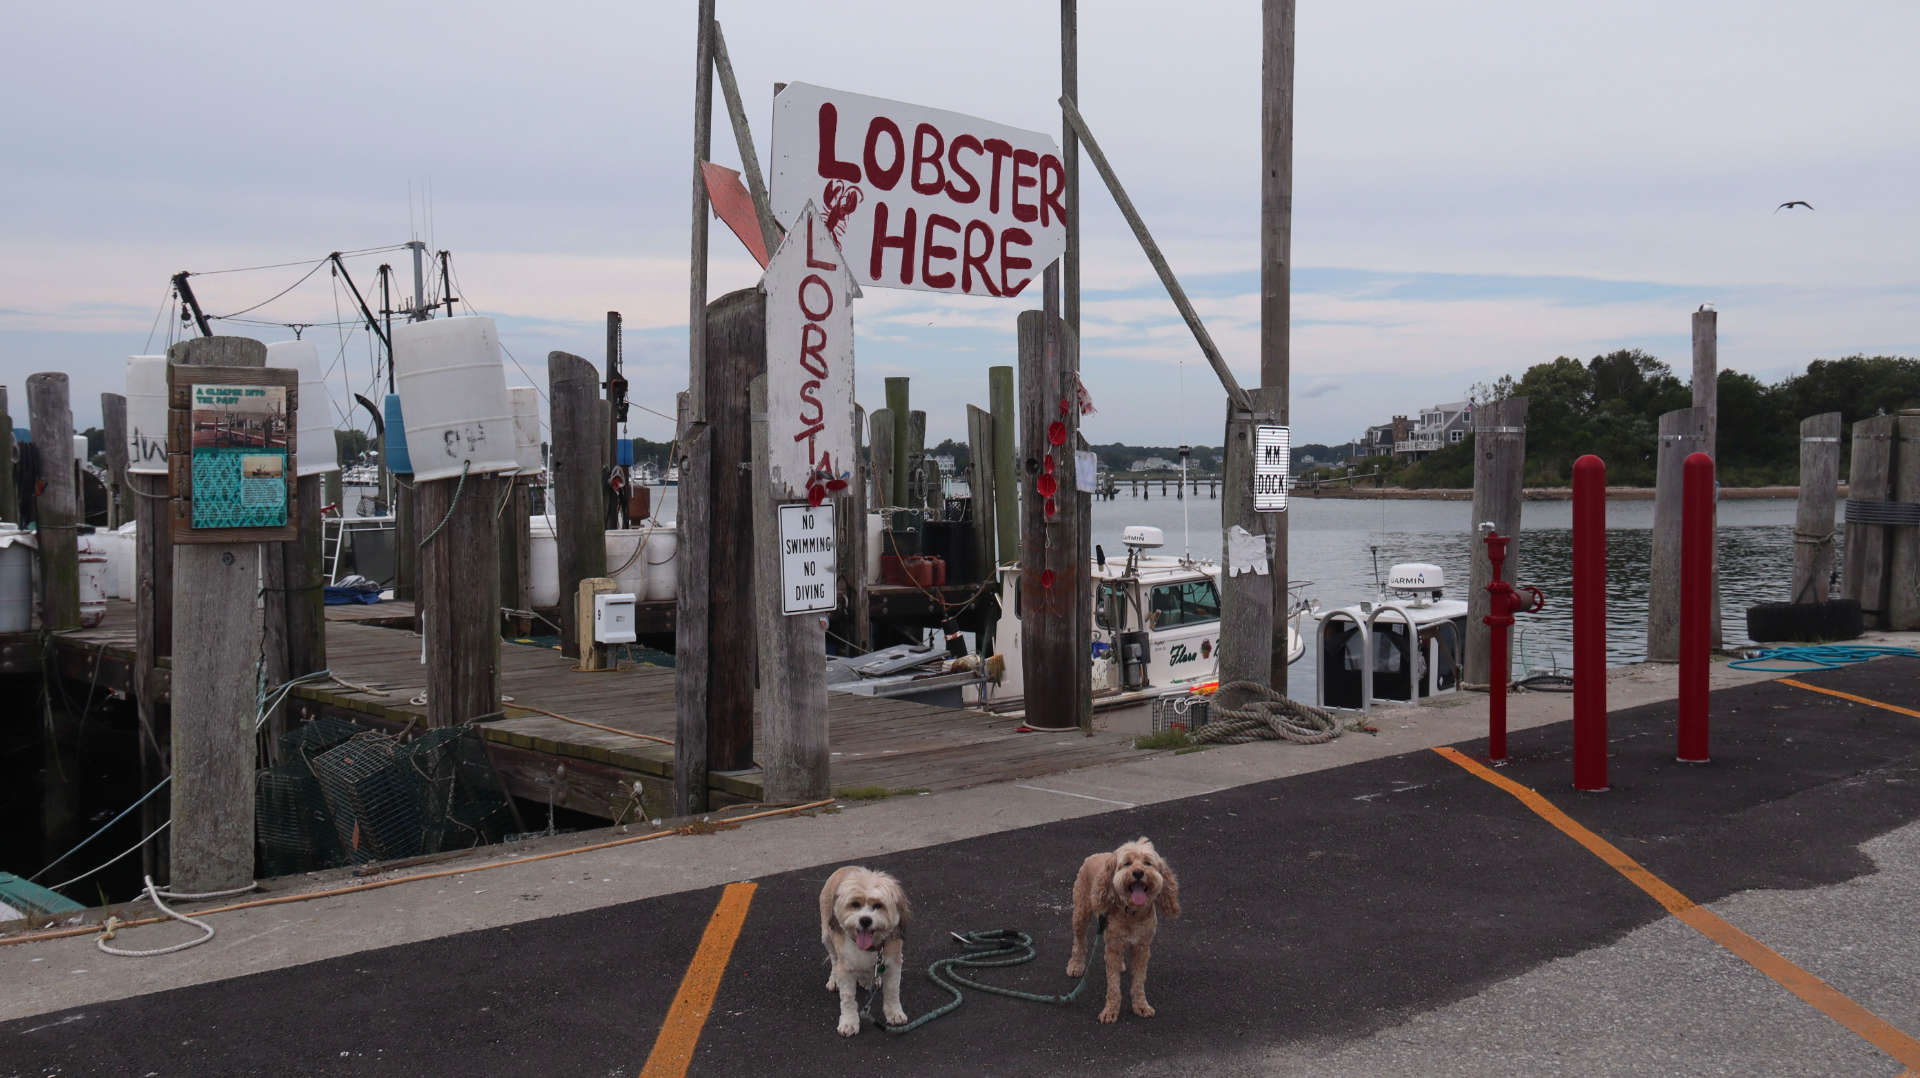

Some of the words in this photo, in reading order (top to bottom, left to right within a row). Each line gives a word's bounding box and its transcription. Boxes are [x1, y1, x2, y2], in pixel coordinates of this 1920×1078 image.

[818, 102, 1066, 228] LOBSTER
[869, 201, 1033, 297] HERE
[1265, 445, 1280, 465] MM
[1258, 474, 1285, 494] DOCK
[802, 514, 814, 530] NO
[786, 536, 831, 555] SWIMMING
[803, 561, 816, 577] NO
[795, 583, 825, 601] DIVING
